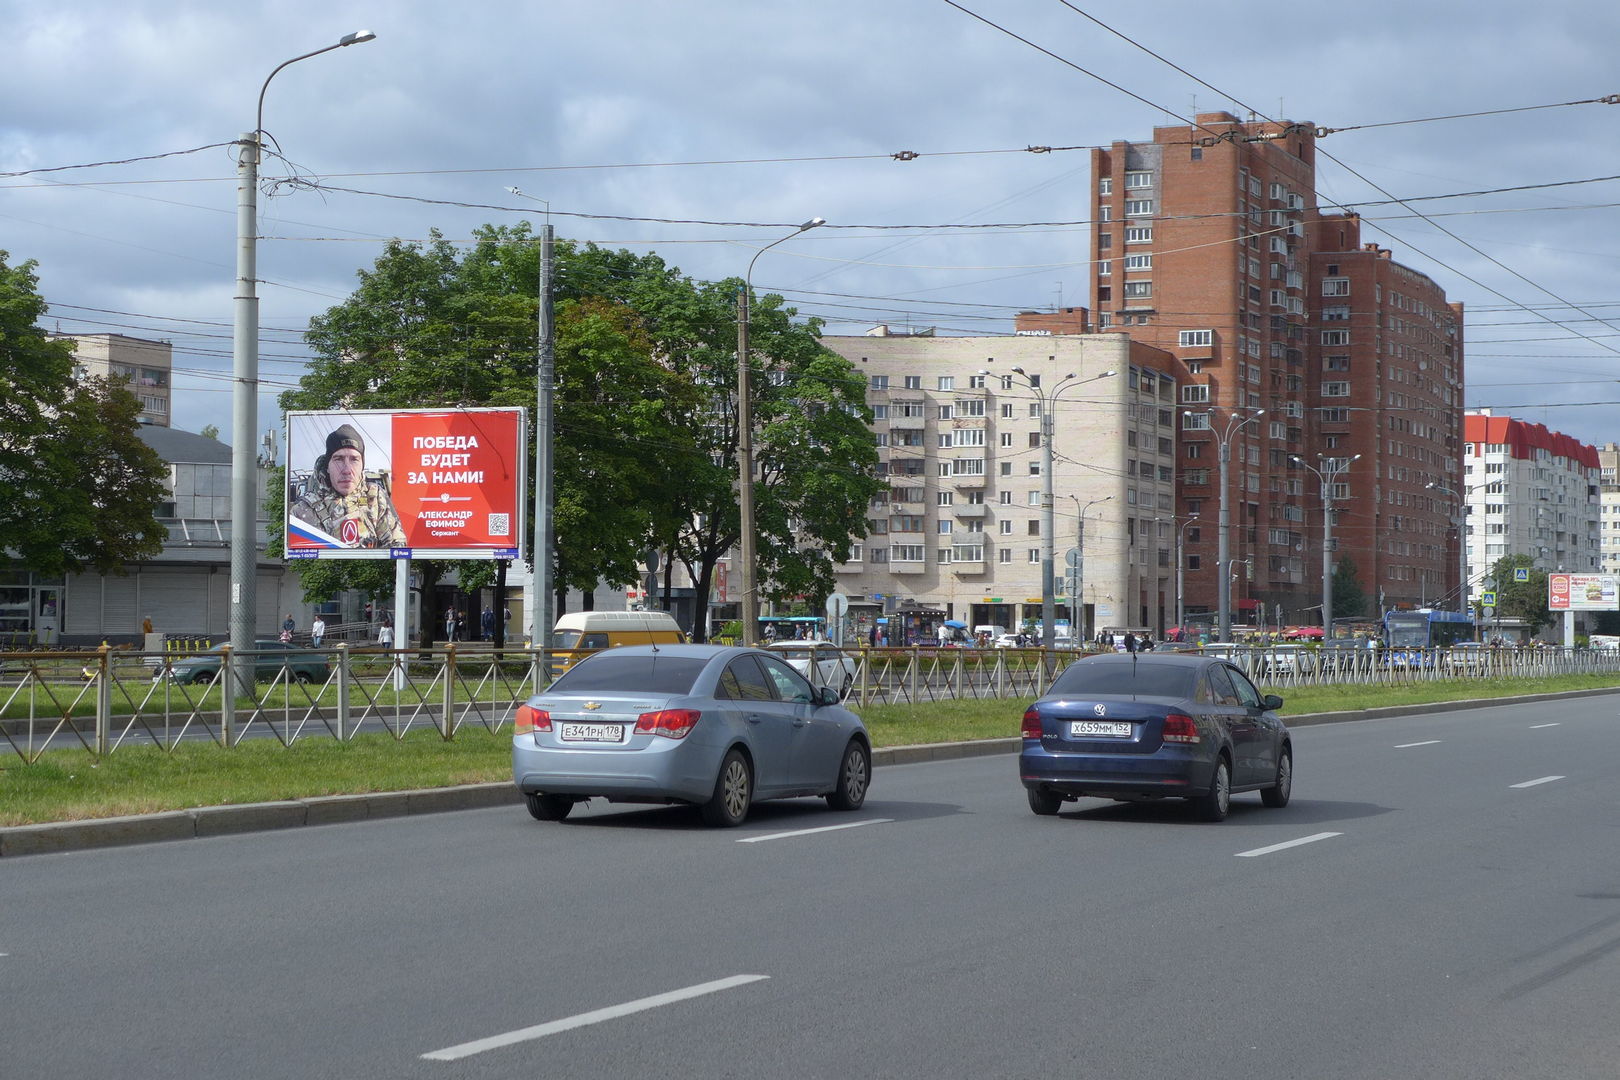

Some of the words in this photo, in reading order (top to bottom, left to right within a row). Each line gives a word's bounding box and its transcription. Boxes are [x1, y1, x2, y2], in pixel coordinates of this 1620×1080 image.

[413, 436, 479, 450] ПОБЕДА
[421, 454, 471, 468] БУДЕТ
[407, 472, 428, 484] ЗА
[432, 471, 484, 484] НАМИ!
[417, 511, 473, 519] АЛЕКСАНДР
[425, 520, 465, 528] ЕФИМОВ
[606, 726, 620, 735] 178
[1114, 723, 1129, 731] 152
